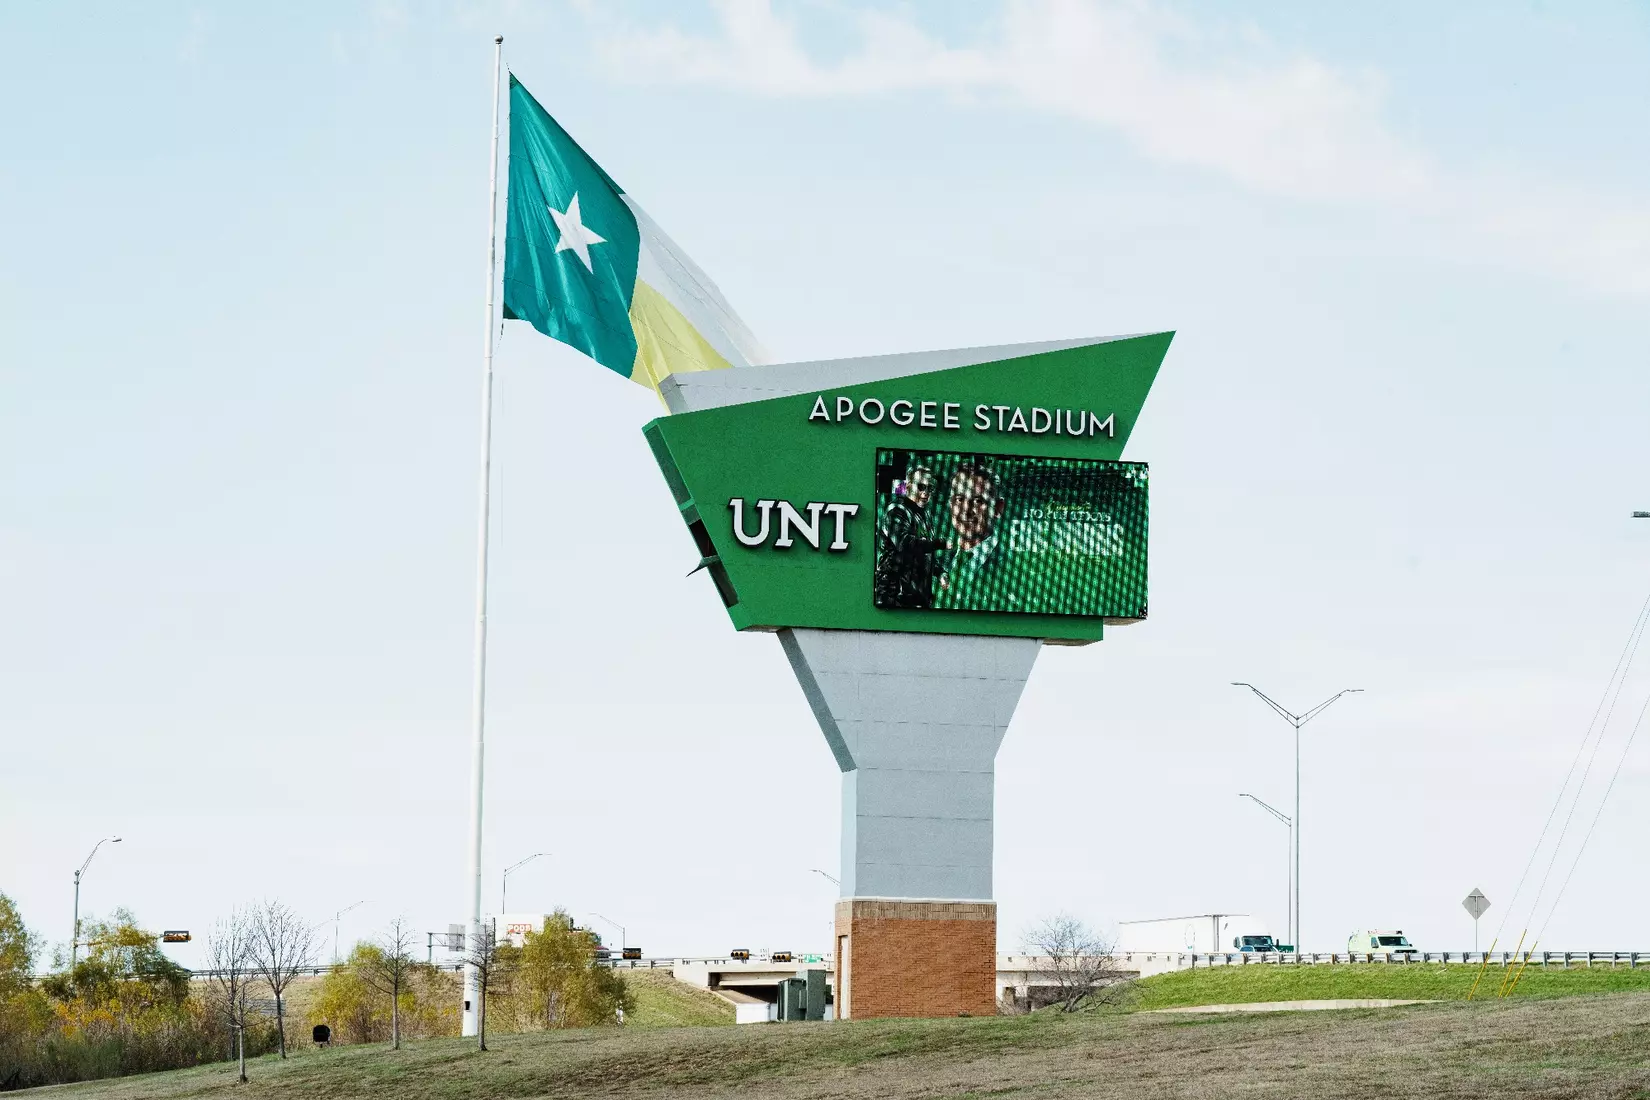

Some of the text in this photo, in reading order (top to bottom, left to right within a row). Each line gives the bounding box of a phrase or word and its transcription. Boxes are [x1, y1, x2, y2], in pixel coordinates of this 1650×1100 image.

[809, 395, 1114, 437] APOGEE STADIUM
[729, 498, 860, 551] UNT
